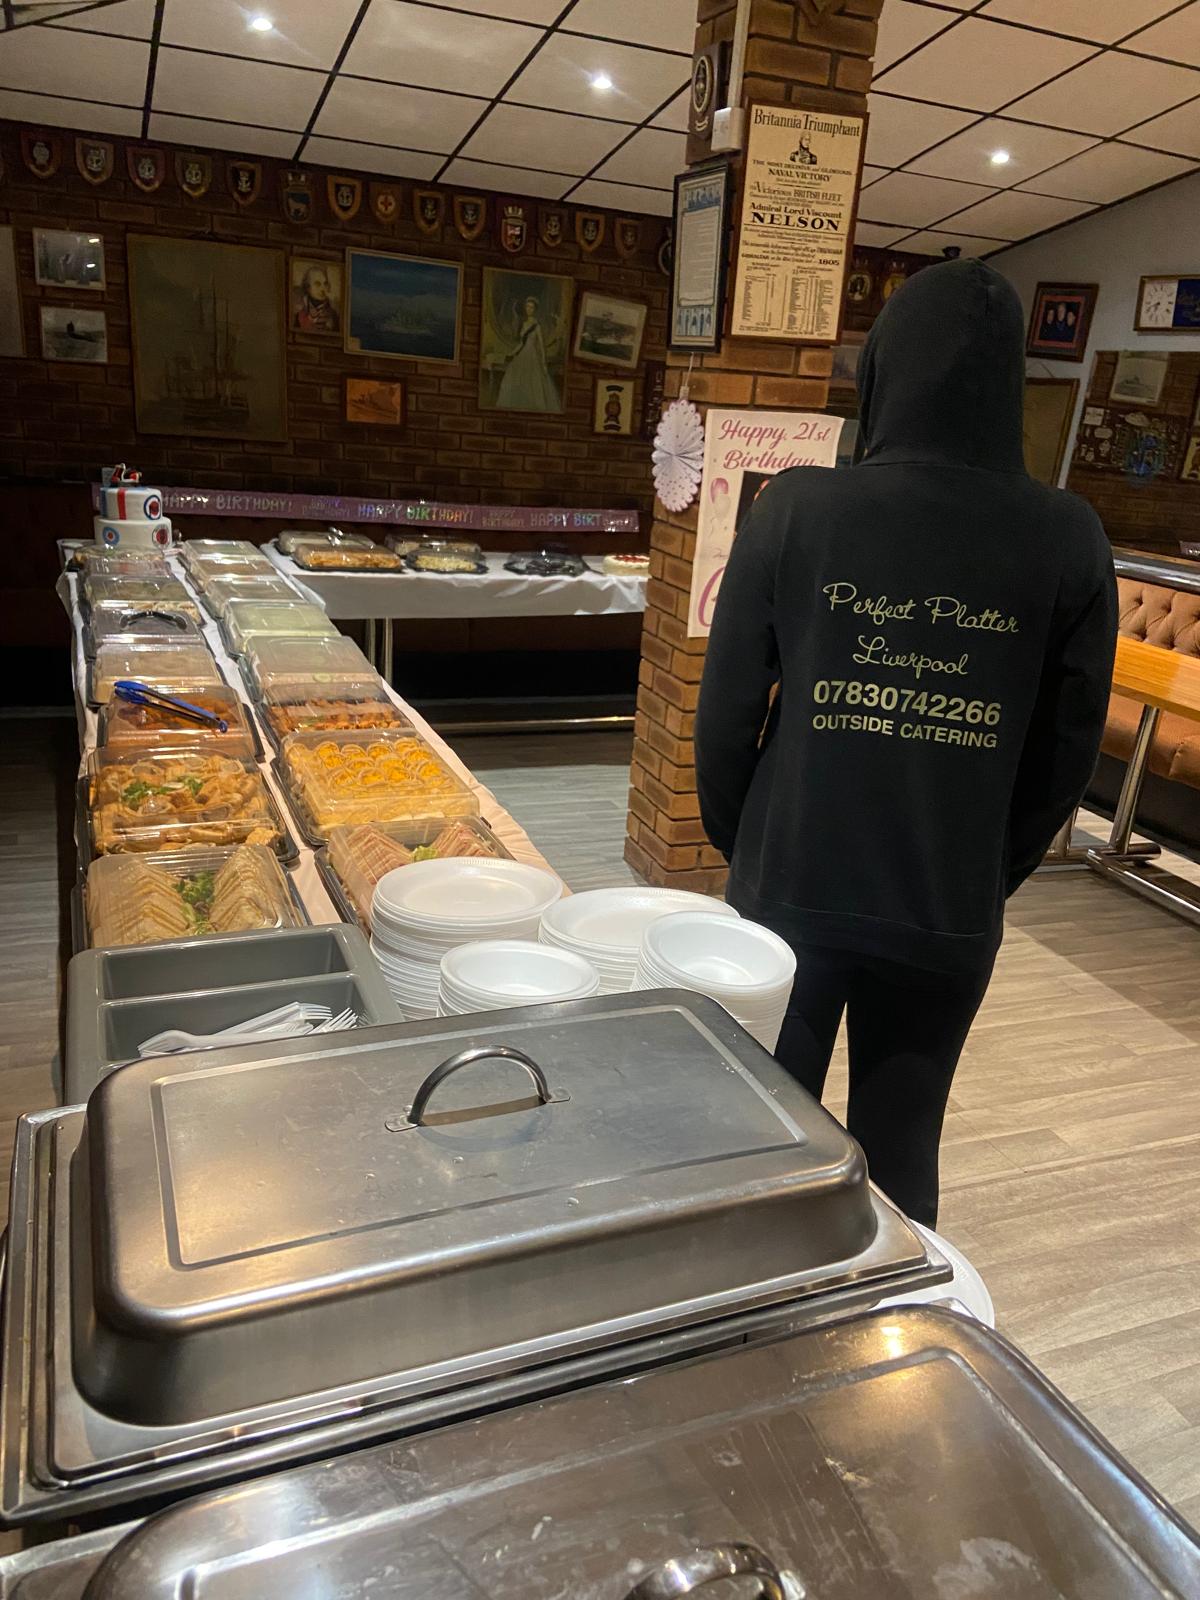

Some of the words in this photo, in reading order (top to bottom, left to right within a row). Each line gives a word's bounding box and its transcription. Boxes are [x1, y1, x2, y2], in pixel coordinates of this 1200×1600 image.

[754, 108, 802, 129] Britannia
[802, 113, 860, 138] Triumphant
[768, 168, 794, 178] NAVAL
[795, 171, 832, 182] VICTORY
[793, 189, 821, 199] BRITISH
[821, 192, 843, 202] FLEET
[750, 202, 782, 213] Admiral
[783, 205, 805, 215] Lord
[805, 209, 842, 219] Viscount
[750, 211, 841, 231] NELSON
[817, 258, 840, 266] 1805
[793, 421, 831, 442] 21st
[215, 493, 293, 513] BIRTHDAY!
[358, 502, 402, 520] HAPPY
[406, 504, 473, 524] BIRTHDAY!
[530, 512, 570, 528] HAPPY
[822, 582, 917, 626] Perfect
[924, 595, 1020, 633] Platter
[852, 635, 969, 679] Liverpool
[813, 680, 1002, 726] 07830742266
[812, 713, 895, 736] OUTSIDE
[900, 722, 998, 749] CATERING
